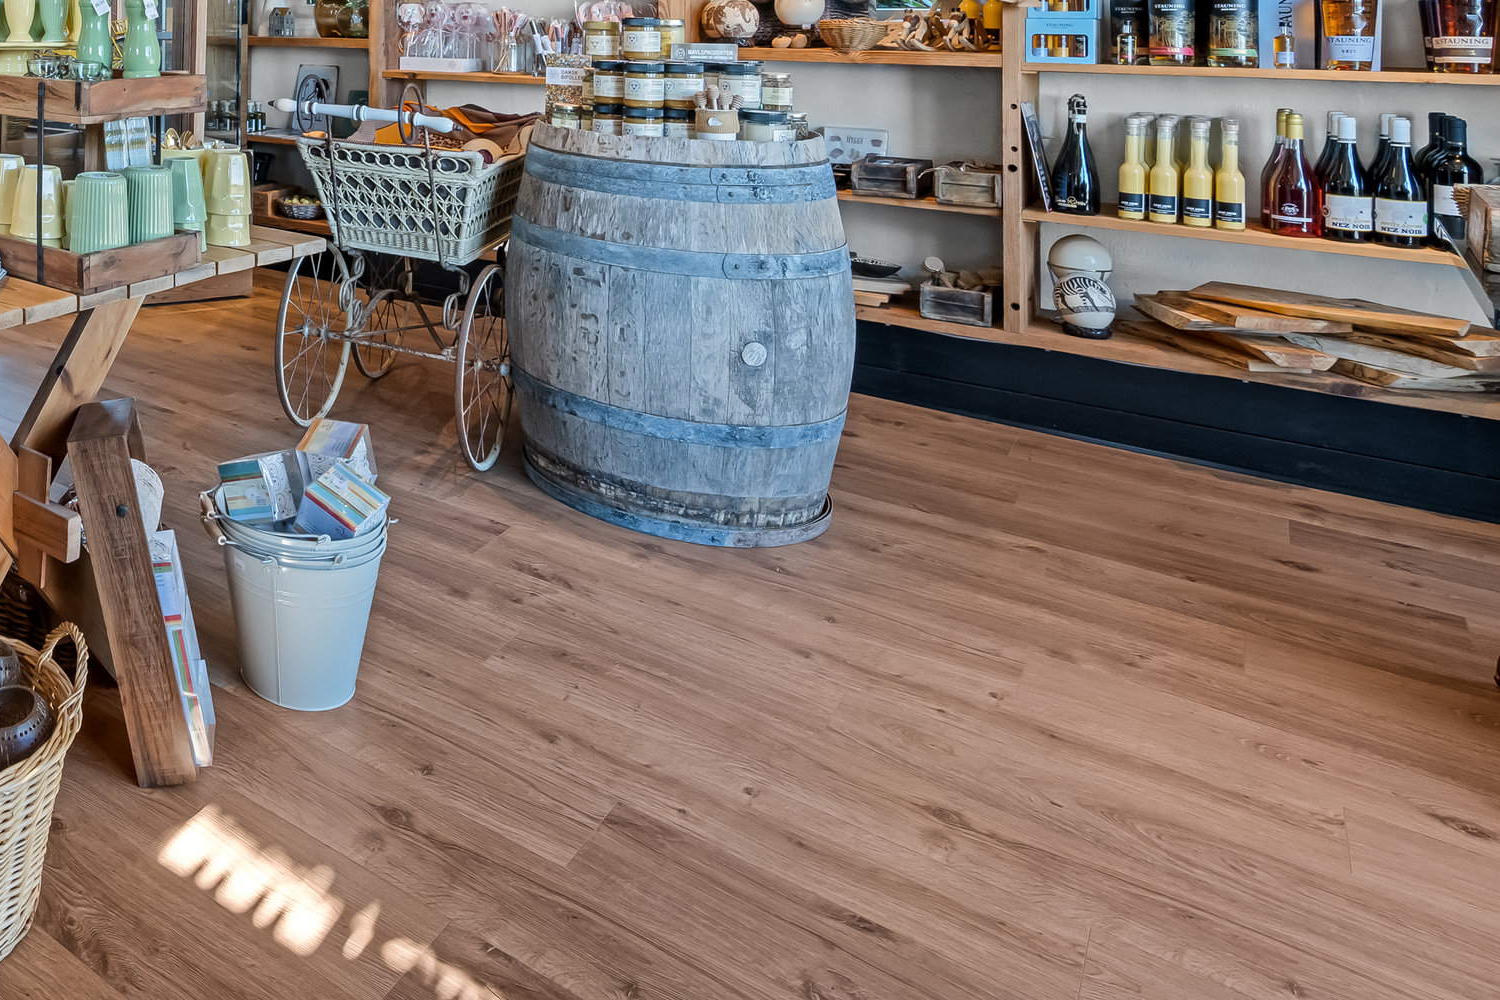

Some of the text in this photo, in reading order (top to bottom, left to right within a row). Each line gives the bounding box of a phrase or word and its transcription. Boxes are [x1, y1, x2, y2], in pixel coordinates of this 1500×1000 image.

[1440, 37, 1488, 45] STAUNING
[846, 134, 864, 145] HYGGE
[1332, 221, 1350, 229] NEZ
